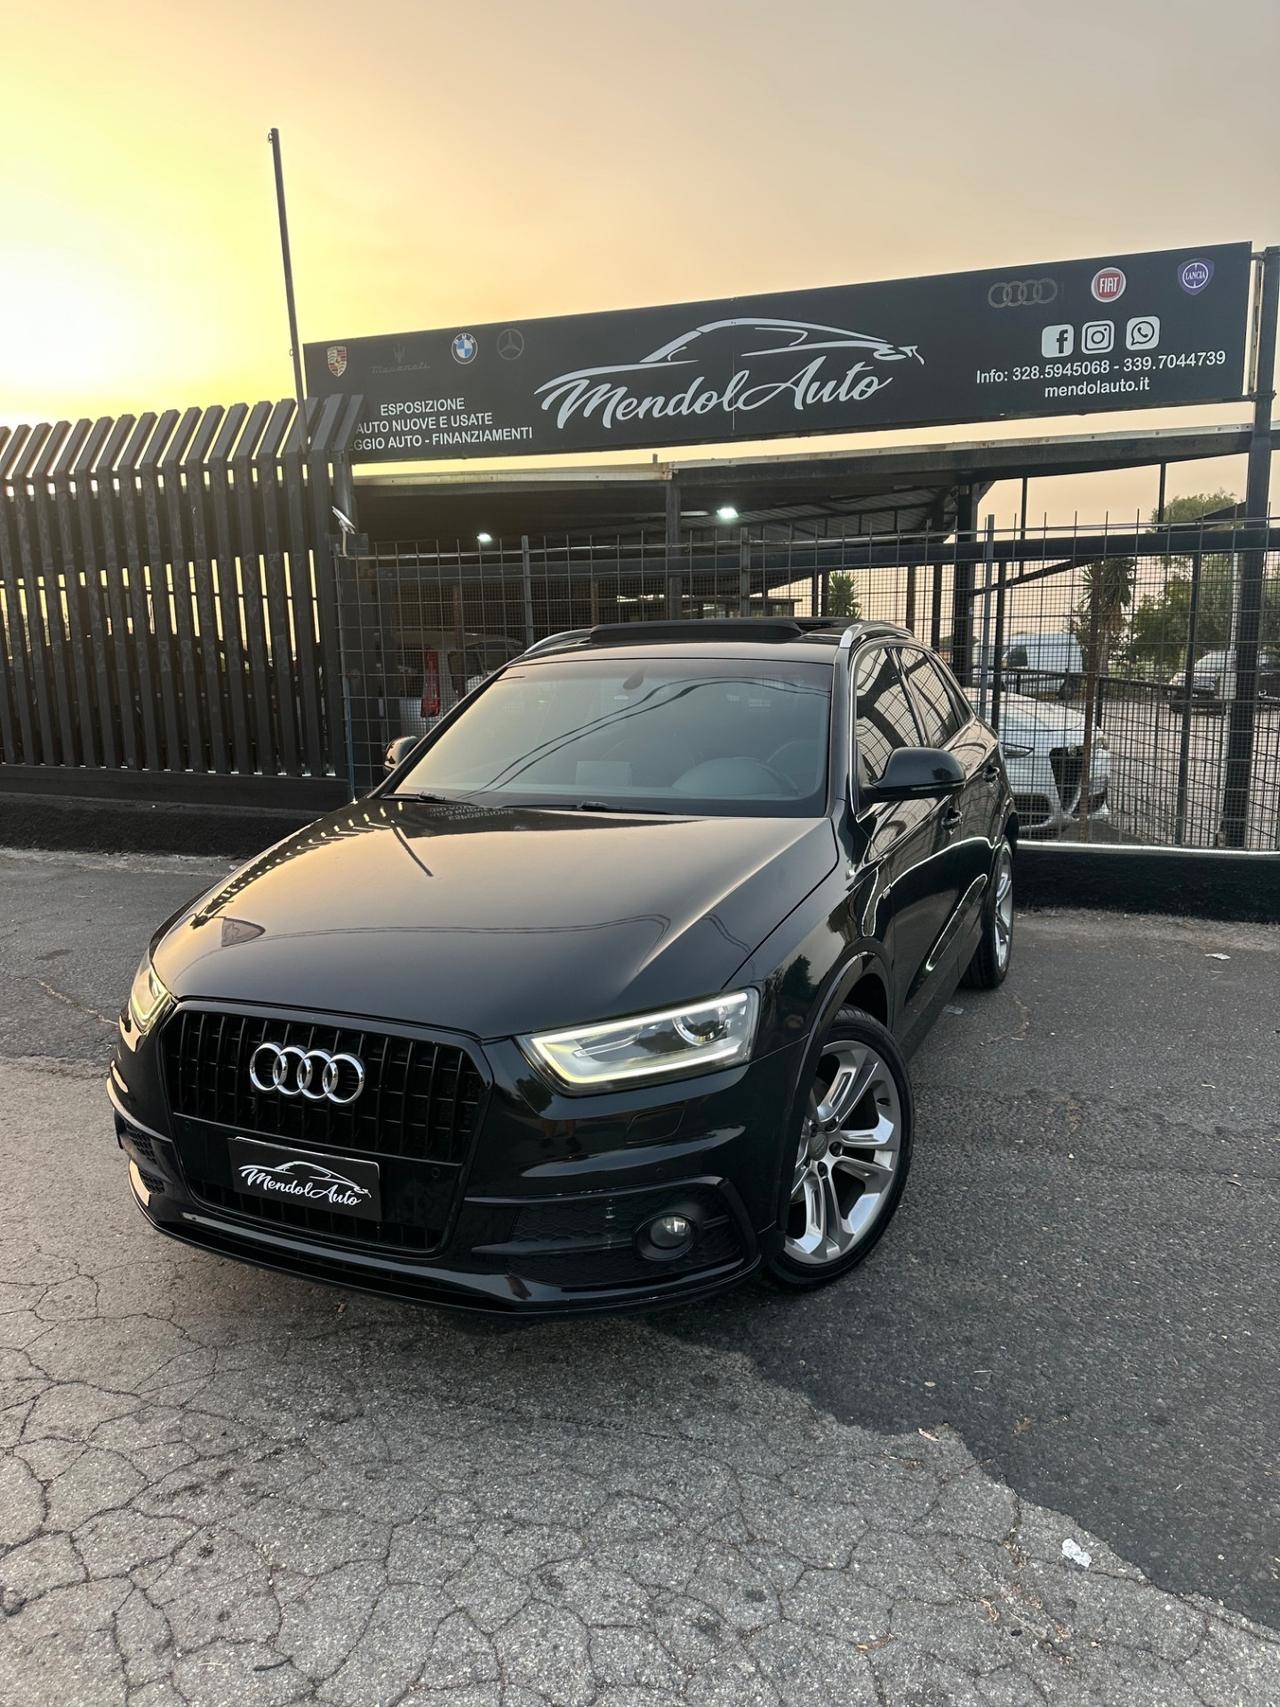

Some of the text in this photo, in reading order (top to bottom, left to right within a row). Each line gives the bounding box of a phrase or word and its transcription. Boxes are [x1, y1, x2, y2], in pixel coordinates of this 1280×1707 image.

[1099, 277, 1120, 293] FIAT
[1185, 270, 1206, 281] LANCIA
[976, 369, 1008, 384] Info:
[1012, 360, 1110, 381] 328.5945068
[1123, 350, 1226, 371] 339.7044739
[541, 356, 894, 429] MendolAuto
[1044, 377, 1150, 398] mendolauto.it
[380, 397, 465, 416] ESPOSIZIONE
[356, 412, 493, 435] AUTO NUOVE E USATE
[353, 436, 385, 451] GGIO
[388, 433, 422, 449] AUTO
[432, 426, 533, 446] FINANZIAMENTI
[240, 1168, 362, 1206] MendolAuto
